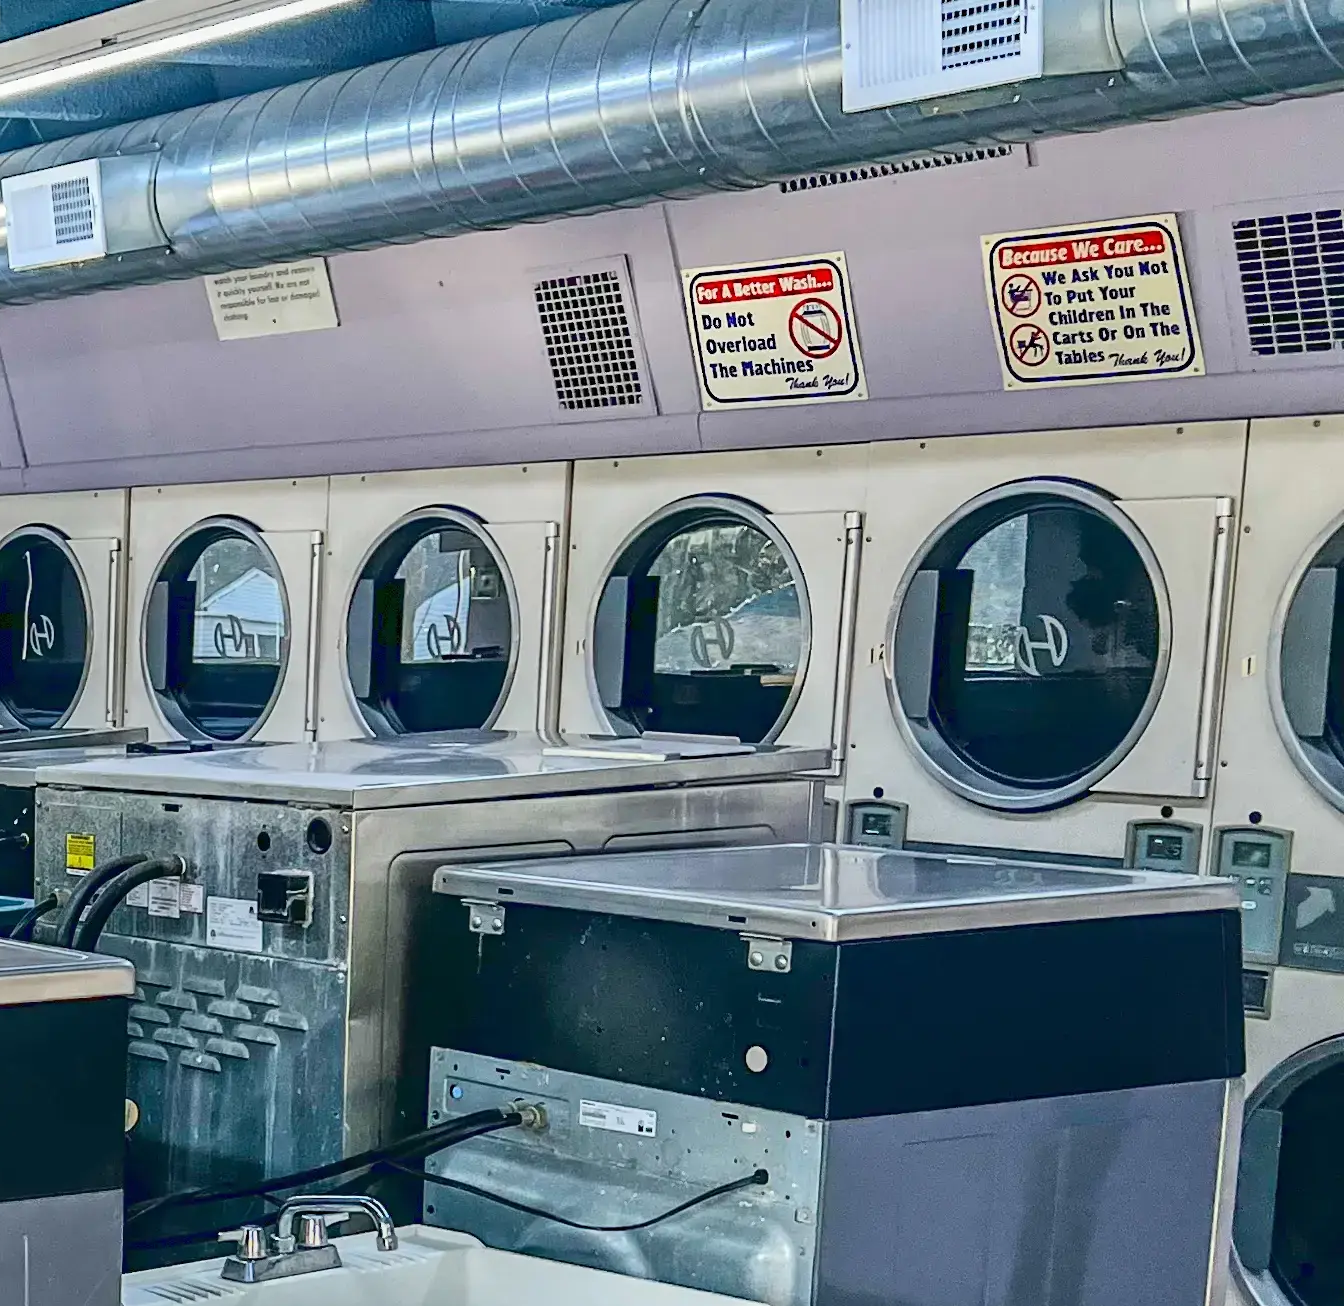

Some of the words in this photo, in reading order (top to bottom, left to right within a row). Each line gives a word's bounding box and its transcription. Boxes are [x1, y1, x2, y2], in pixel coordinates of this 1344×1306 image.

[1002, 246, 1068, 267] Because
[1071, 242, 1099, 260] We
[1102, 237, 1163, 256] Care...
[1041, 271, 1066, 286] We
[1071, 268, 1100, 283] Ask
[1104, 265, 1134, 280] You
[1138, 260, 1169, 276] Not
[697, 285, 719, 302] For
[721, 285, 732, 299] A
[733, 280, 776, 297] Better
[778, 273, 833, 292] Wash...
[1044, 292, 1062, 306] To
[1066, 289, 1095, 305] Put
[1098, 286, 1136, 301] Your
[701, 313, 722, 330] Do
[725, 311, 755, 328] Not
[1048, 308, 1115, 326] Children
[1119, 305, 1136, 319] In
[1139, 302, 1171, 317] The
[705, 333, 777, 354] Overload
[1052, 329, 1094, 345] Carts
[1098, 326, 1117, 342] Or
[1123, 324, 1146, 339] On
[1149, 322, 1181, 337] The
[1055, 349, 1105, 365] Tables
[1108, 351, 1149, 367] Thank
[1153, 347, 1186, 367] You!
[709, 362, 738, 379] The
[741, 358, 814, 377] Machines
[785, 375, 819, 390] Thank
[822, 372, 850, 390] You!
